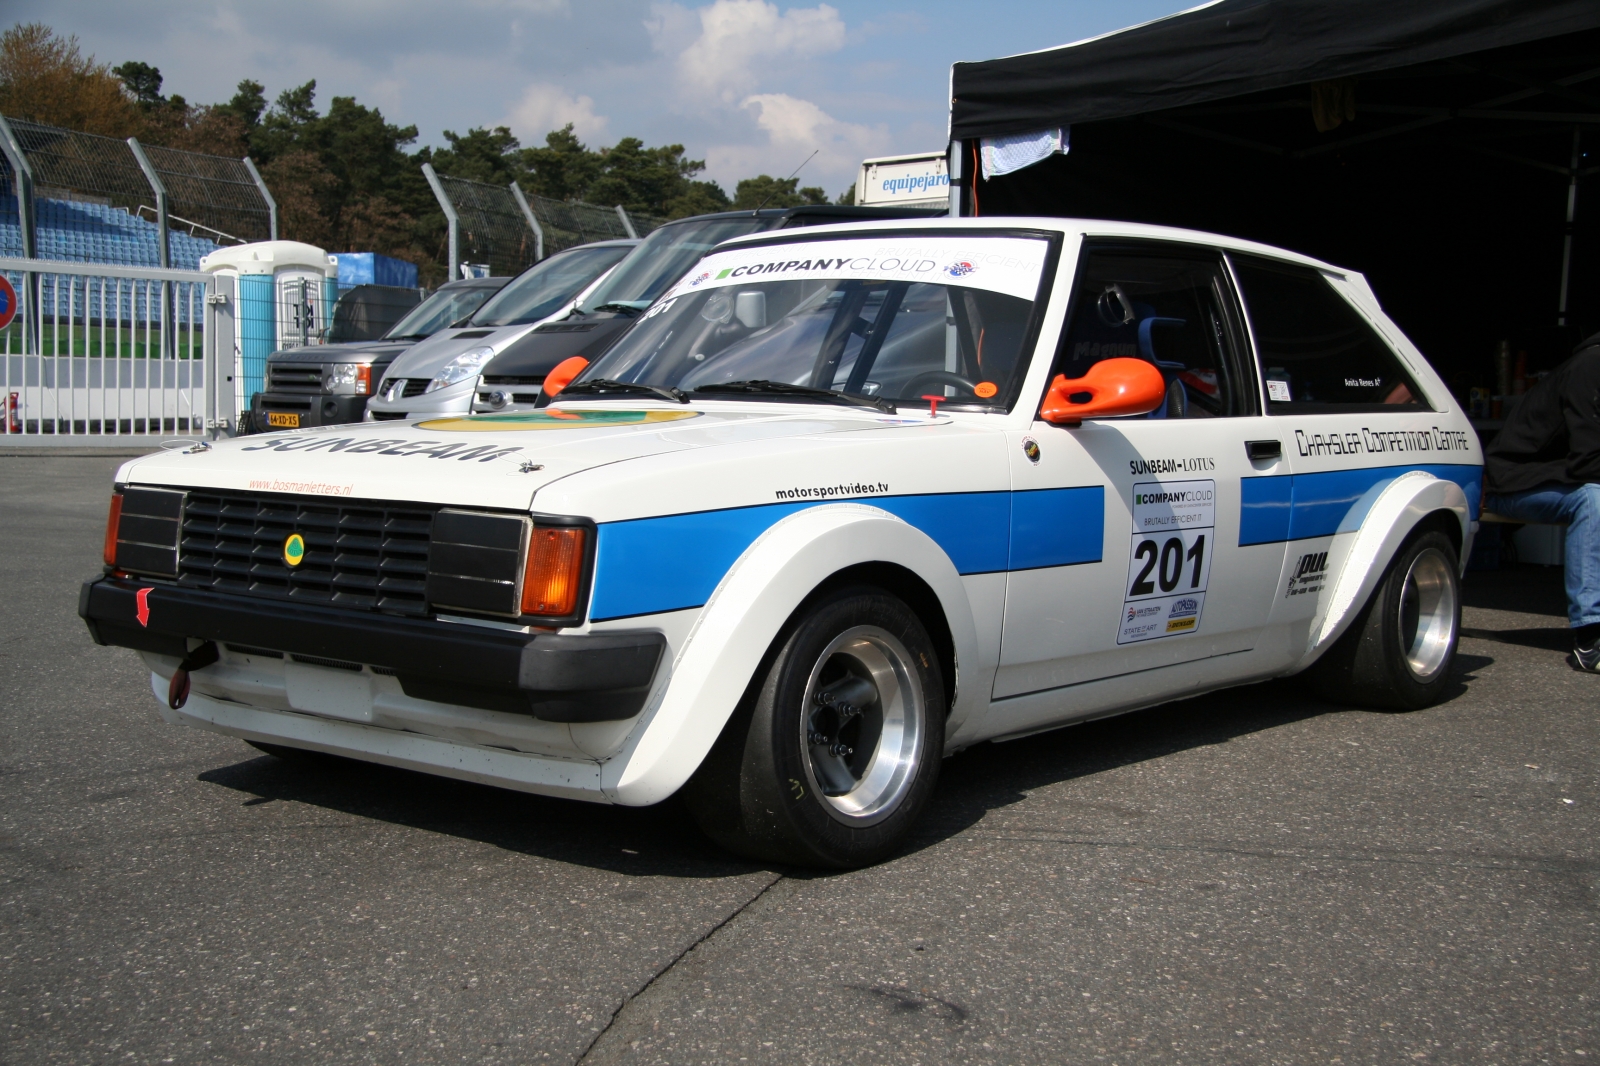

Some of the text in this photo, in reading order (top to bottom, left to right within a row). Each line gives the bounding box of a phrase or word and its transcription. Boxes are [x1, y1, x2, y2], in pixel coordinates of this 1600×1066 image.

[731, 258, 936, 278] COMPANYCLOUD
[1073, 341, 1137, 361] Magnum
[241, 437, 524, 463] SUNBEAM
[249, 478, 354, 496] www.bosmanletters.nl
[775, 482, 889, 499] motorsportvideo.tv
[1142, 490, 1213, 505] COMPANYCLOUD
[1144, 516, 1170, 526] BRUTALLY
[1171, 514, 1196, 524] EFFICIENT
[1129, 534, 1205, 597] 201
[1124, 626, 1141, 635] STATE
